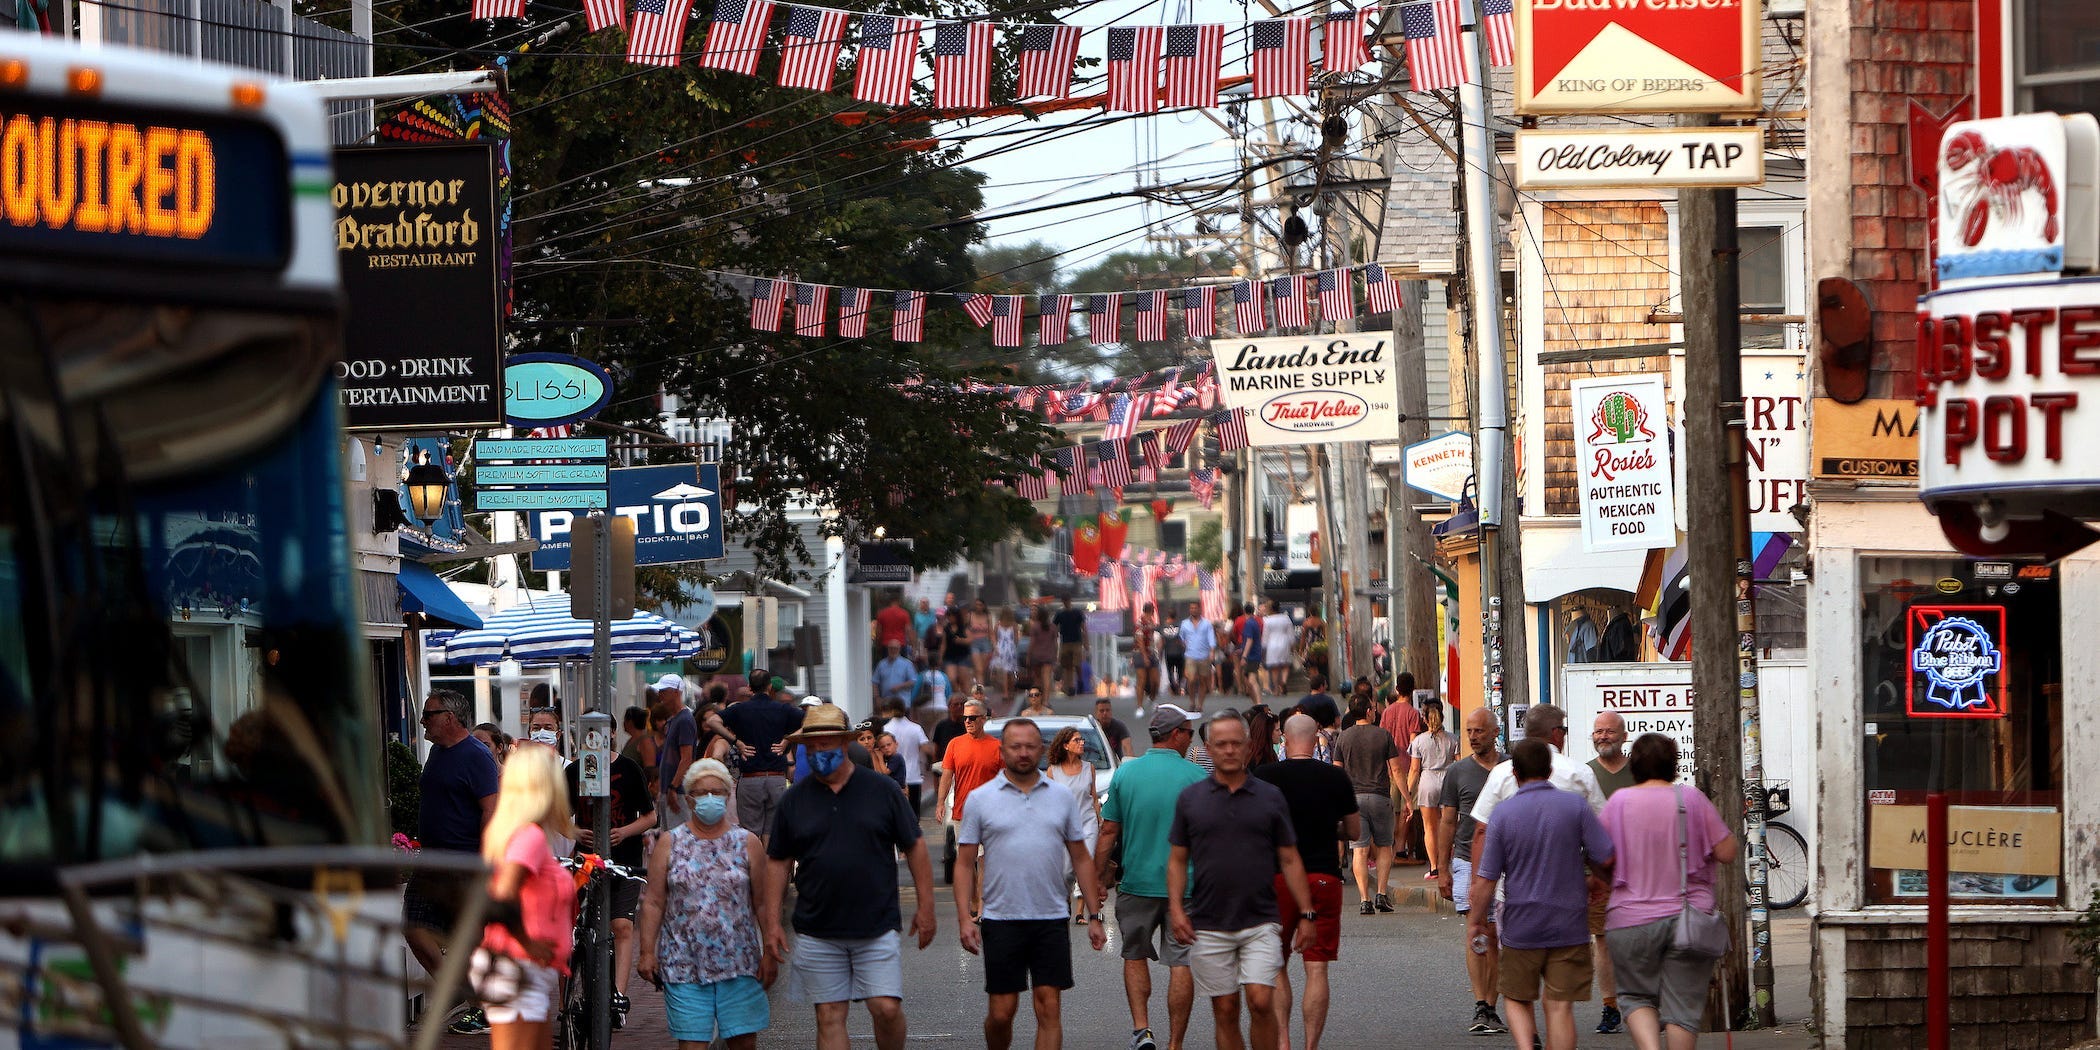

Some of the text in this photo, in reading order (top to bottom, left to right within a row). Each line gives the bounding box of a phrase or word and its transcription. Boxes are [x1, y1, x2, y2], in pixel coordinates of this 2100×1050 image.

[1558, 79, 1704, 92] KING OF BEERS
[1587, 144, 1673, 175] Colony
[1682, 142, 1743, 170] TAP
[0, 113, 215, 240] QUIRED
[331, 179, 466, 208] overnor
[335, 208, 479, 250] Bradford
[368, 252, 477, 269] RESTAURANT
[1226, 340, 1385, 371] Lands End
[335, 357, 473, 378] OOD DRINK
[1230, 369, 1385, 391] MARINE SUPPLY
[338, 384, 490, 406] TERTAINMENT
[505, 378, 588, 401] LISS!
[1370, 402, 1389, 410] 1940
[1293, 420, 1335, 429] HARDWARE
[1944, 391, 2079, 467] POT
[530, 443, 567, 455] FROZEN
[568, 443, 603, 455] YOGURT
[1413, 449, 1465, 468] KENNETH
[1591, 448, 1657, 481] Rosie's
[1839, 459, 1903, 475] CUSTOM
[477, 470, 606, 481] PREMIUM SOFT ICE CREAM
[480, 494, 603, 505] FRESH FRUIT SMOOTHIES
[1590, 482, 1662, 501] AUTHENTIC
[1599, 502, 1655, 519] MEXICAN
[539, 502, 710, 541] PTIO
[1611, 521, 1646, 536] FOOD
[541, 533, 710, 550] AMERI COCKTAIL BAR
[1935, 629, 1981, 652] Pabst
[1919, 651, 1994, 667] Blue Ribbon
[1942, 667, 1973, 679] BEER
[1602, 690, 1661, 708] RENT
[1666, 691, 1677, 707] a
[1627, 720, 1686, 732] UR DAY
[1870, 791, 1895, 799] ATM
[1909, 827, 2022, 849] MUCLÈRE
